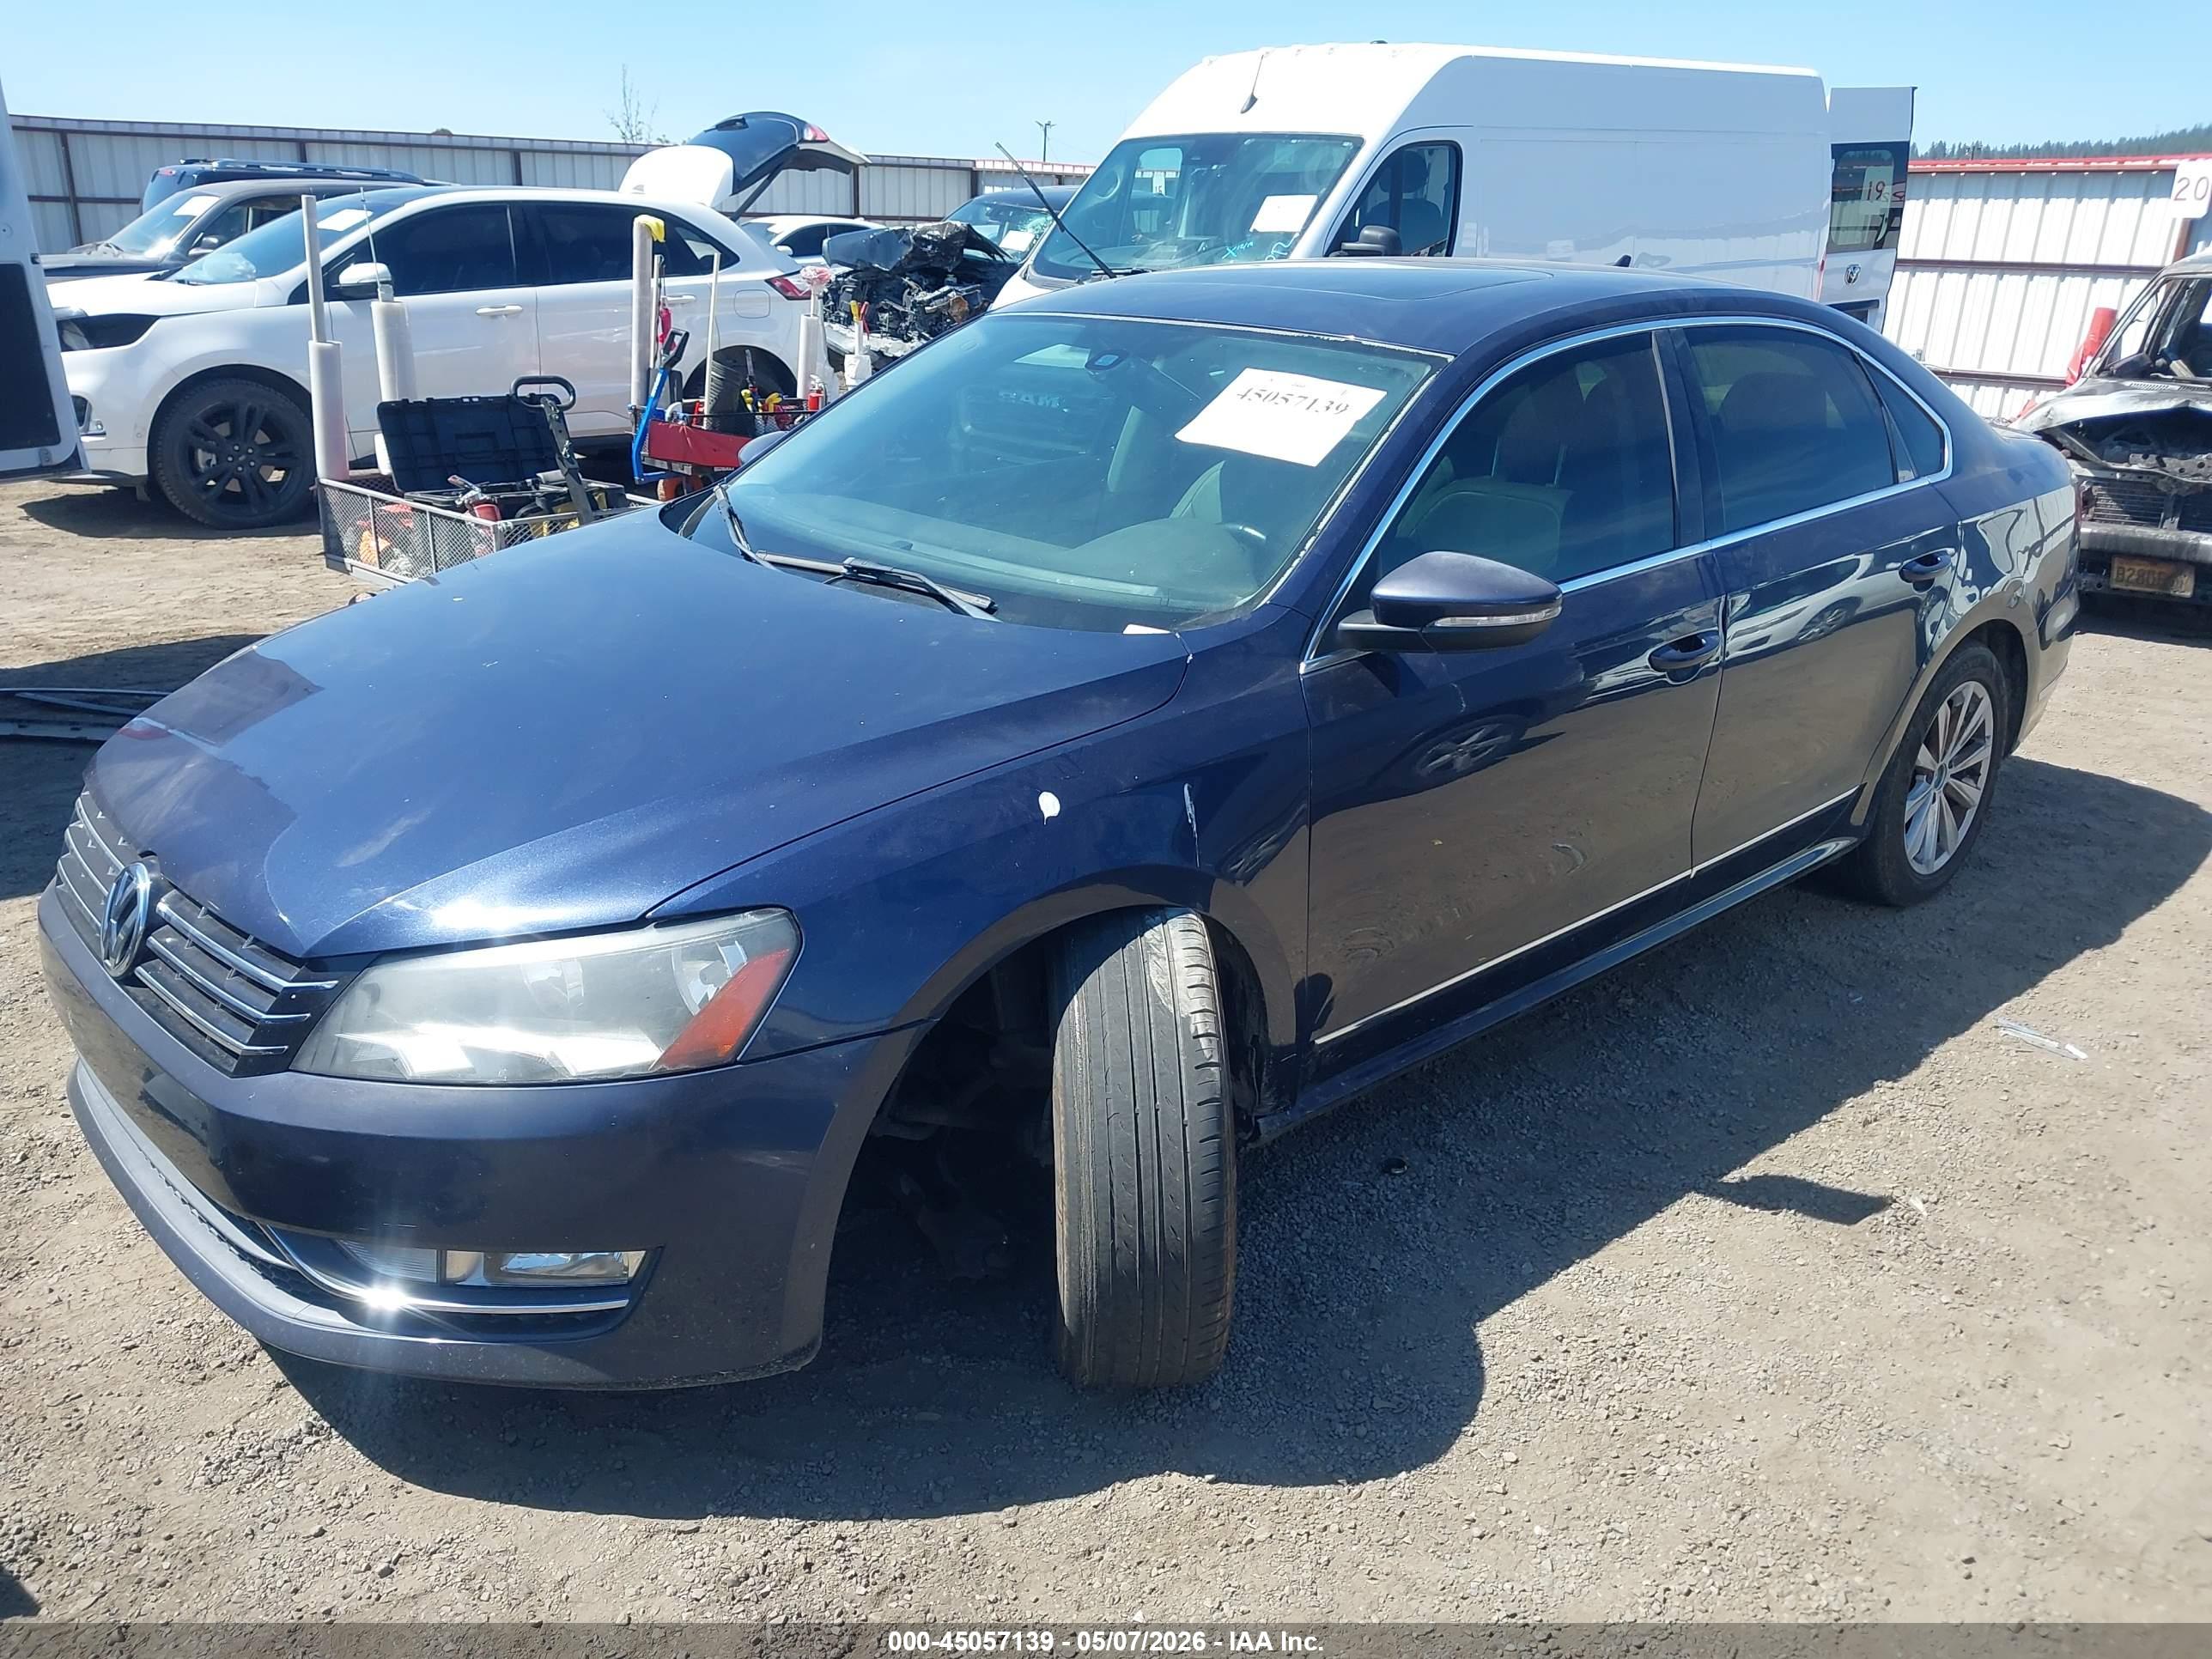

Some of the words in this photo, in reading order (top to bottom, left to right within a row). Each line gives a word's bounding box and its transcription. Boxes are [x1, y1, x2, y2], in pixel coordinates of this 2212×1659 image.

[1867, 180, 1886, 200] 19
[2173, 176, 2209, 201] 20
[1237, 387, 1350, 415] 45057139
